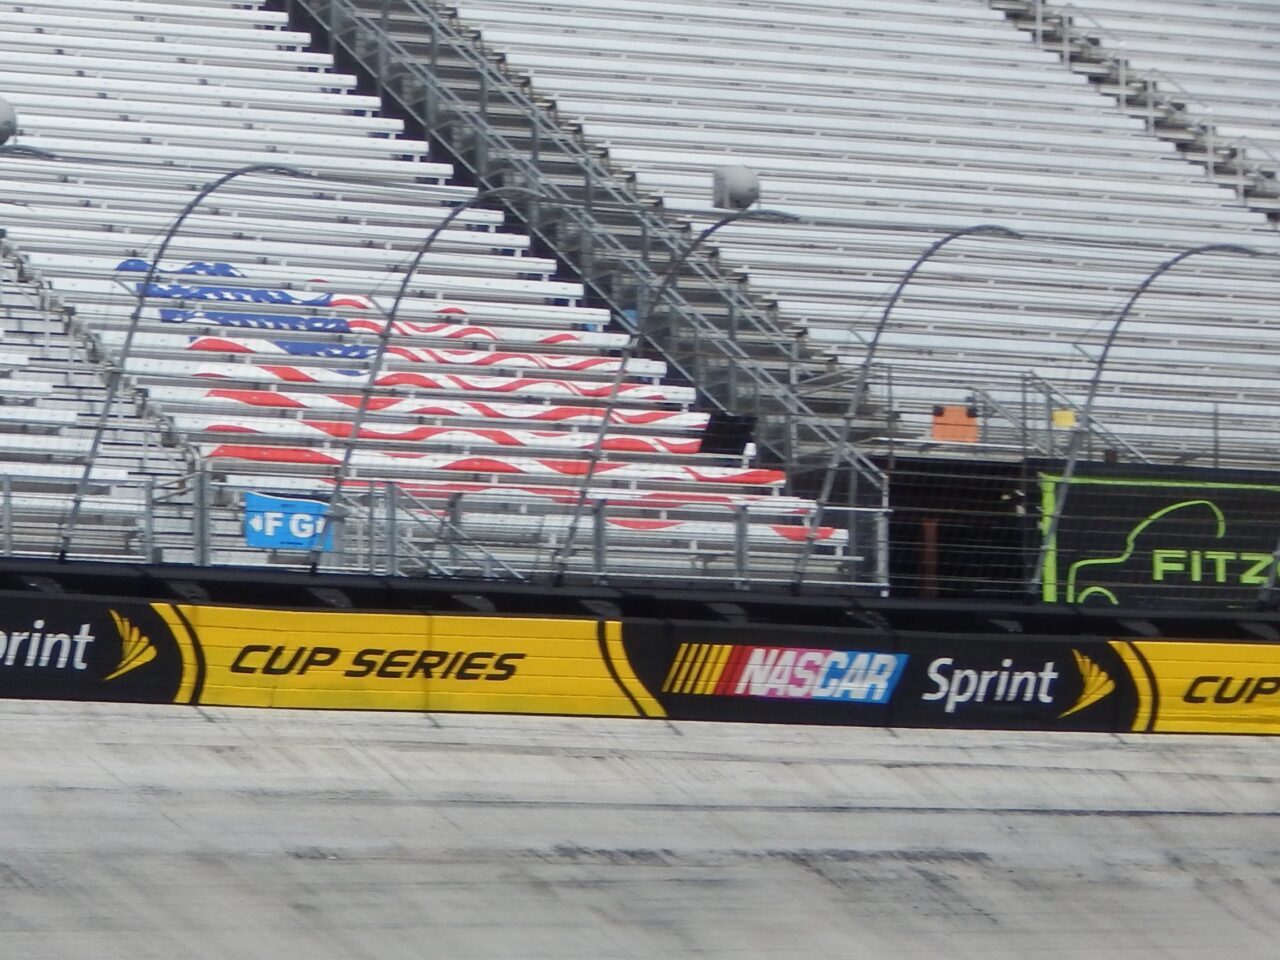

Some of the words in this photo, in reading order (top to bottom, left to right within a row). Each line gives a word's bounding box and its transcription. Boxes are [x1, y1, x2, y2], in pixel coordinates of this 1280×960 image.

[1152, 549, 1280, 584] FITZ
[230, 645, 341, 676] CUP
[344, 648, 527, 681] SERIES
[734, 648, 898, 700] NASCAR
[921, 657, 1059, 714] Sprint
[1182, 675, 1280, 705] CUP
